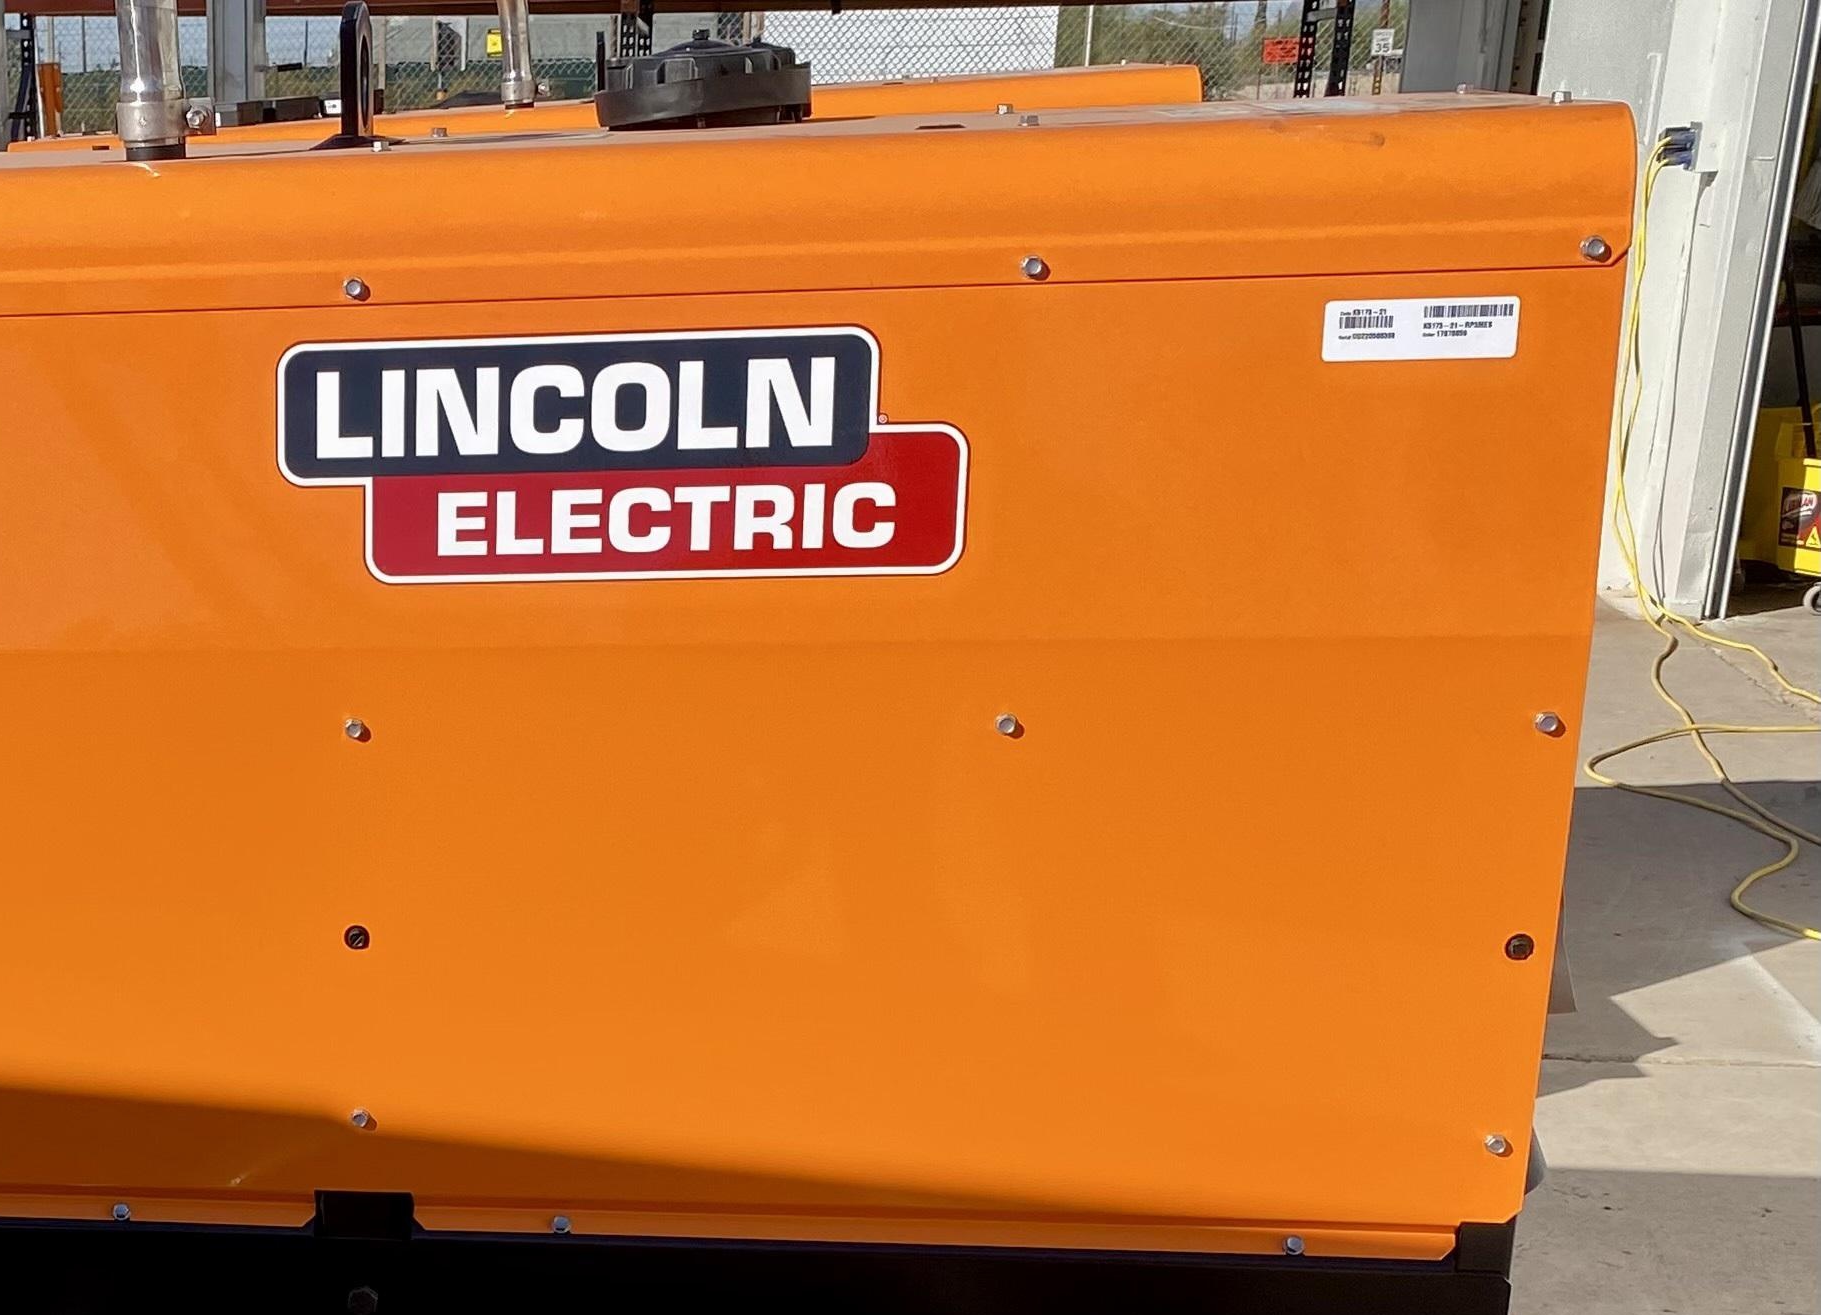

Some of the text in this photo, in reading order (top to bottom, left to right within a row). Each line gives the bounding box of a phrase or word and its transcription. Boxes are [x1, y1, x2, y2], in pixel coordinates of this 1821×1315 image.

[1374, 43, 1390, 53] 35
[316, 356, 836, 460] LINCOLN
[436, 480, 898, 557] ELECTRIC
